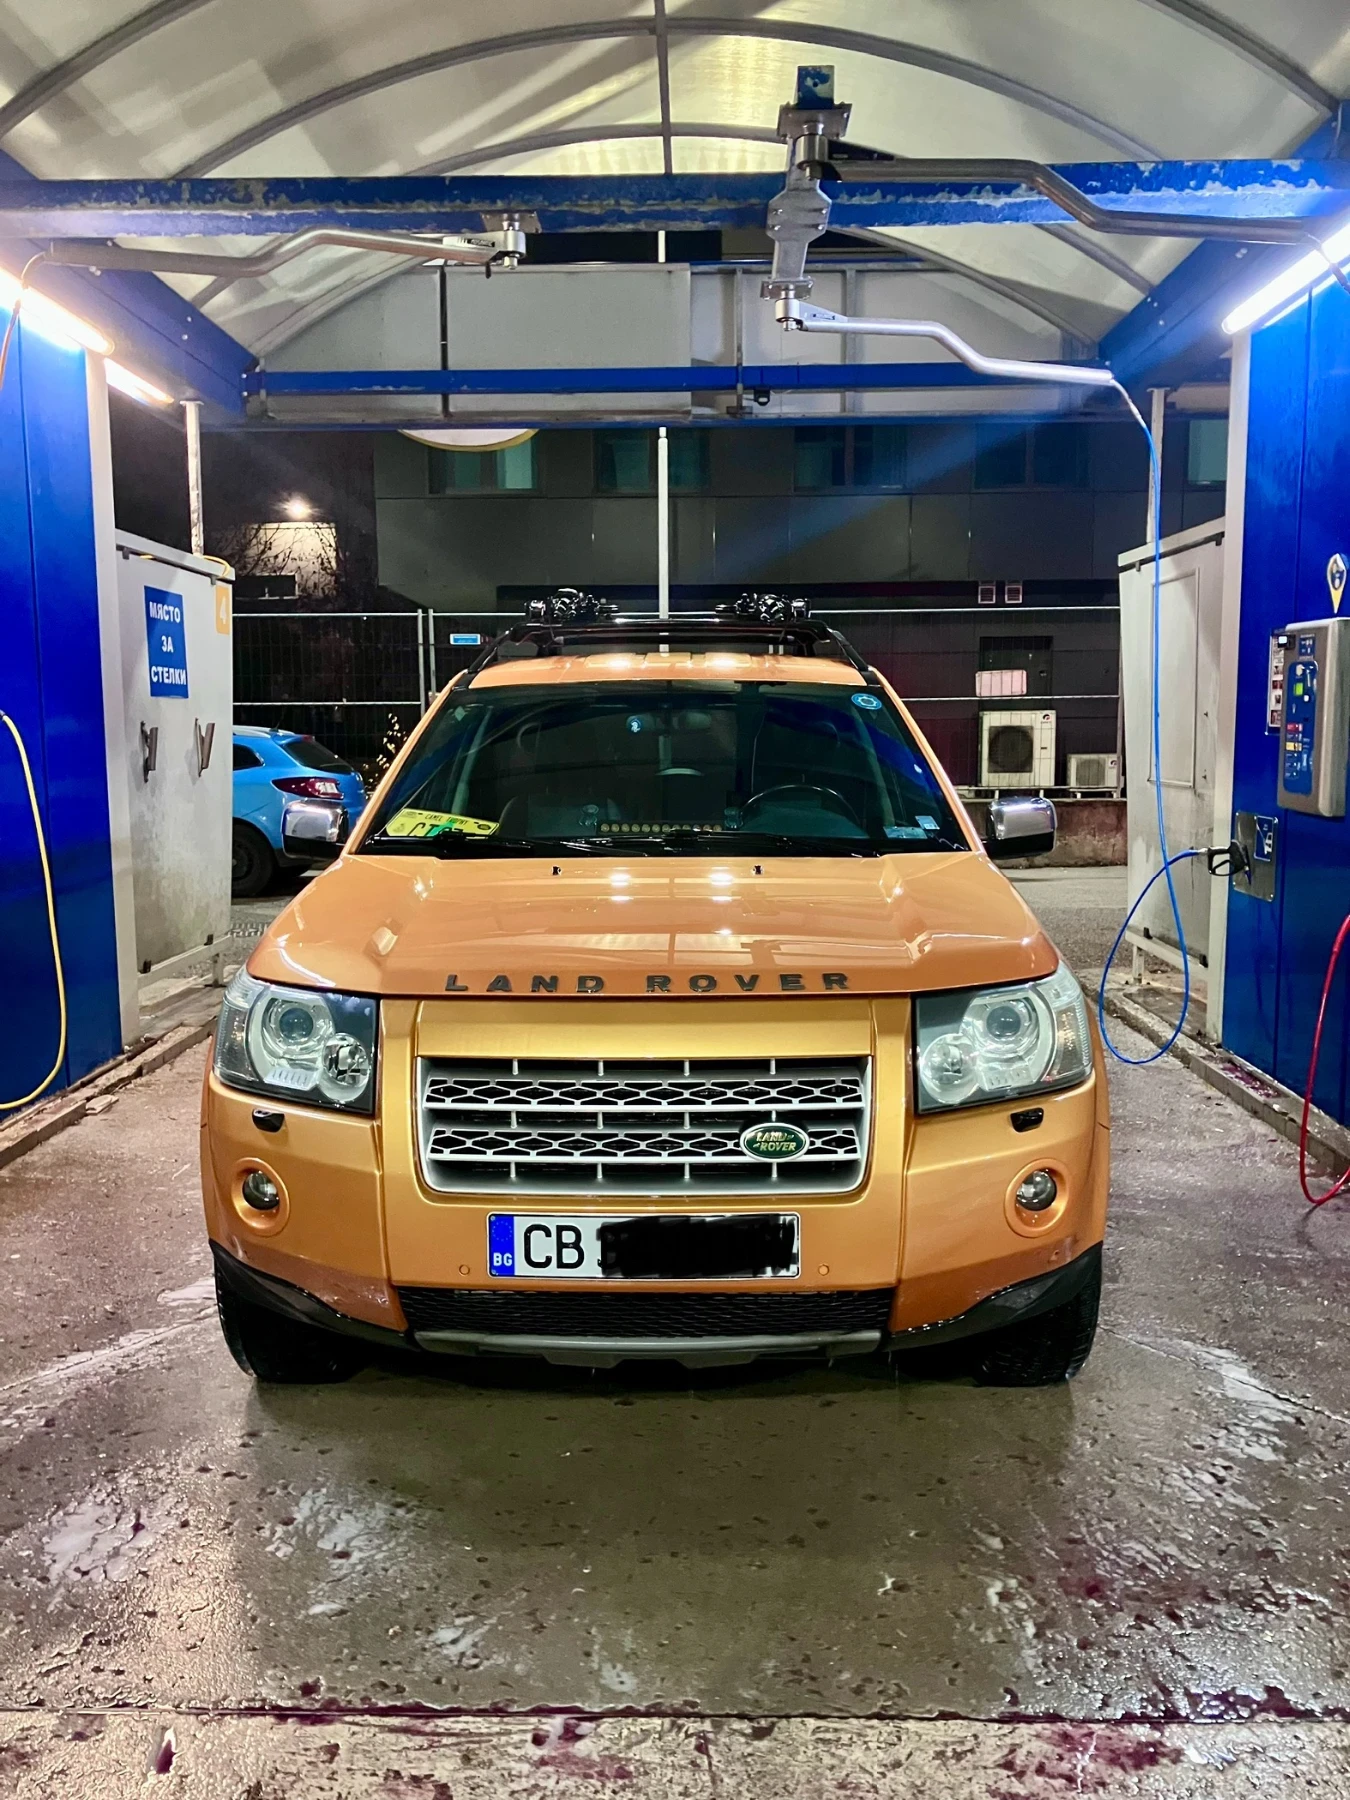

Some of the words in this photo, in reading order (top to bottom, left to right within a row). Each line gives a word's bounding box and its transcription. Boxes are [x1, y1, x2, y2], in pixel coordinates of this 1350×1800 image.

[149, 601, 181, 624] МЯСТО
[219, 596, 227, 625] 4
[161, 635, 174, 653] ЗА
[150, 665, 187, 685] СТЕЛКИ
[445, 973, 606, 994] LAND
[645, 972, 850, 994] ROVER
[756, 1132, 787, 1141] LAND
[760, 1142, 796, 1151] ROVER
[492, 1252, 513, 1267] BG
